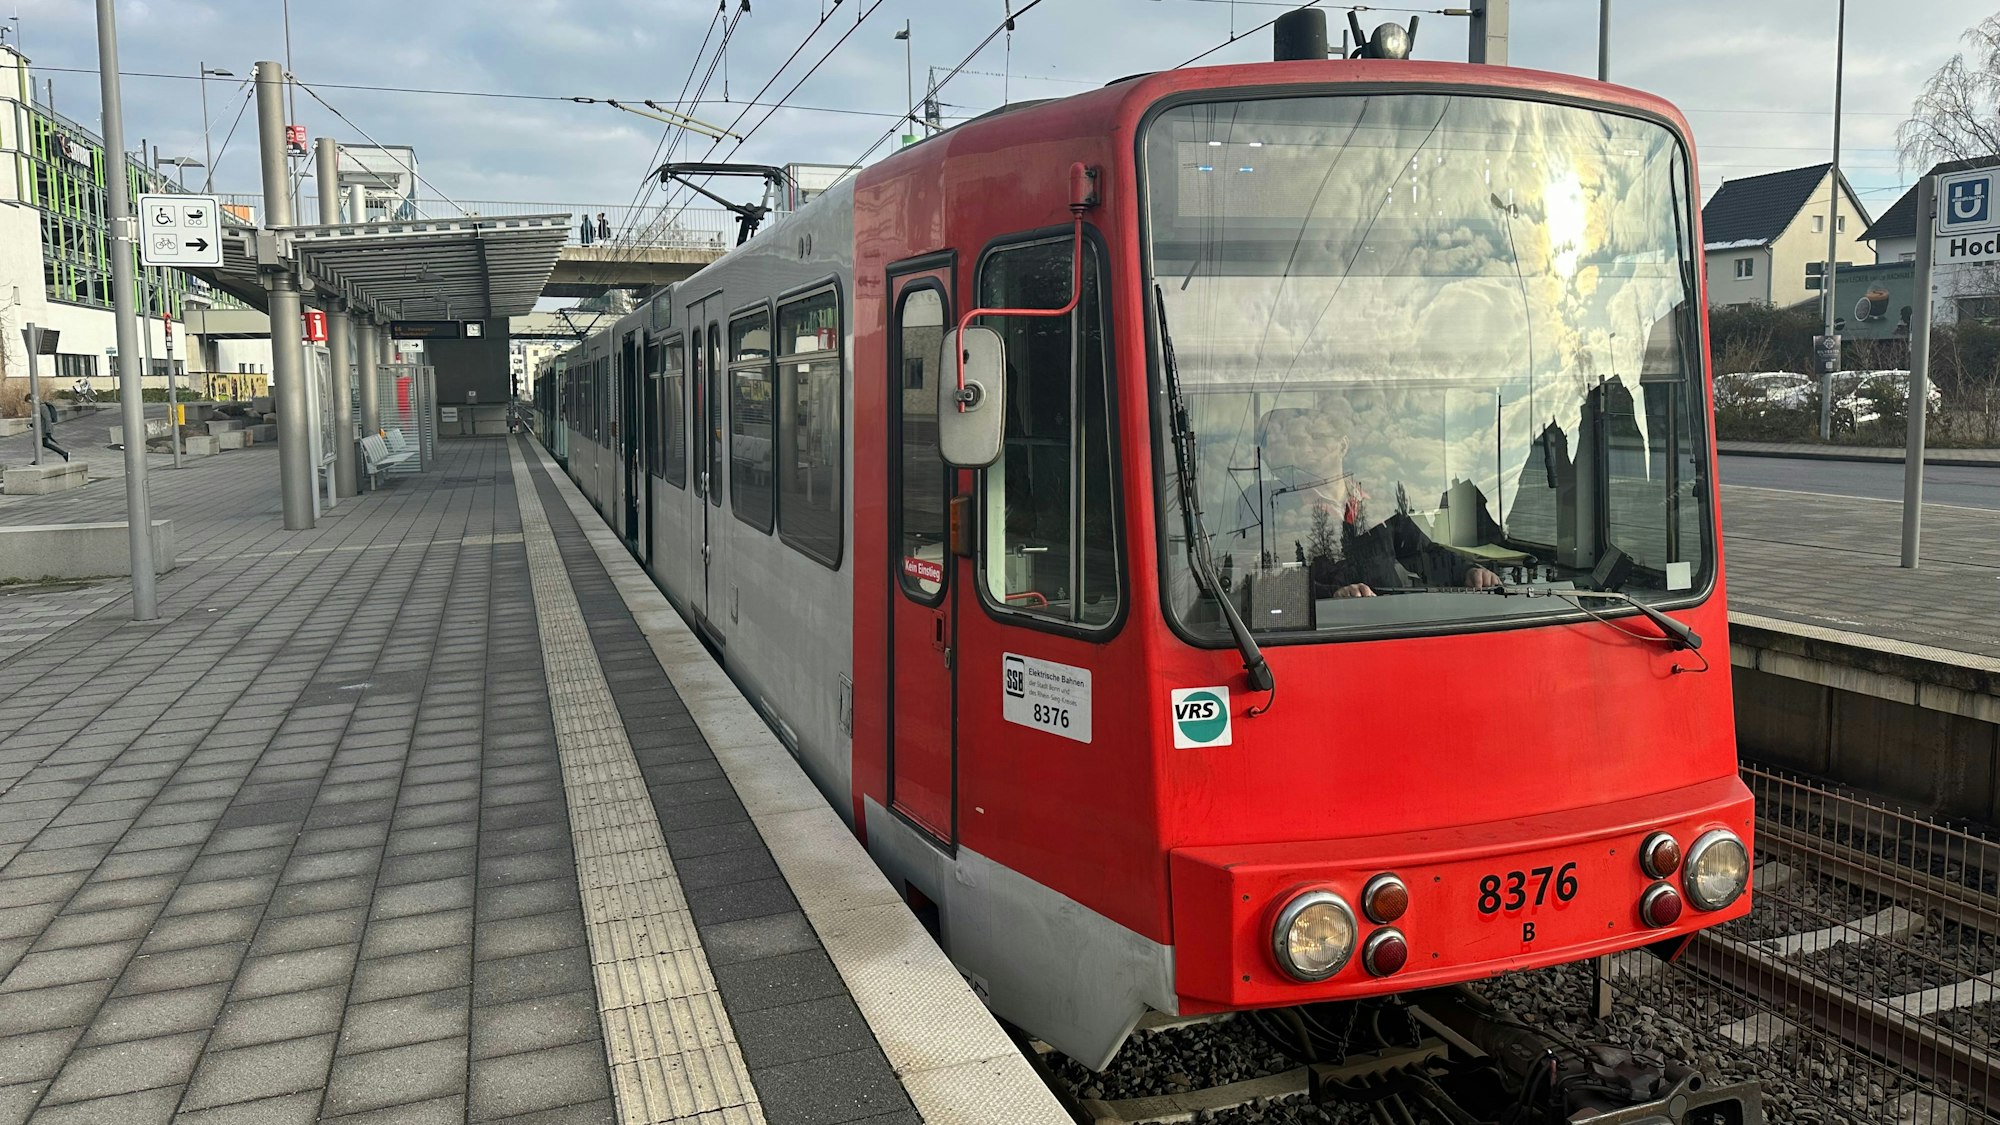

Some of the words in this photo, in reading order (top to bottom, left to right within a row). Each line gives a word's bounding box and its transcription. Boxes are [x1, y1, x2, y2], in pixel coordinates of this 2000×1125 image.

[905, 560, 918, 573] Kein
[918, 563, 941, 582] Einstieg
[1007, 669, 1024, 692] SSB
[1028, 667, 1060, 682] Elektrische
[1061, 675, 1085, 688] Bahnen
[1037, 681, 1049, 689] Stadt
[1049, 684, 1060, 692] Bonn
[1033, 703, 1070, 729] 8376
[1175, 702, 1214, 720] VRS
[1477, 861, 1578, 915] 8376
[1522, 922, 1536, 942] B
